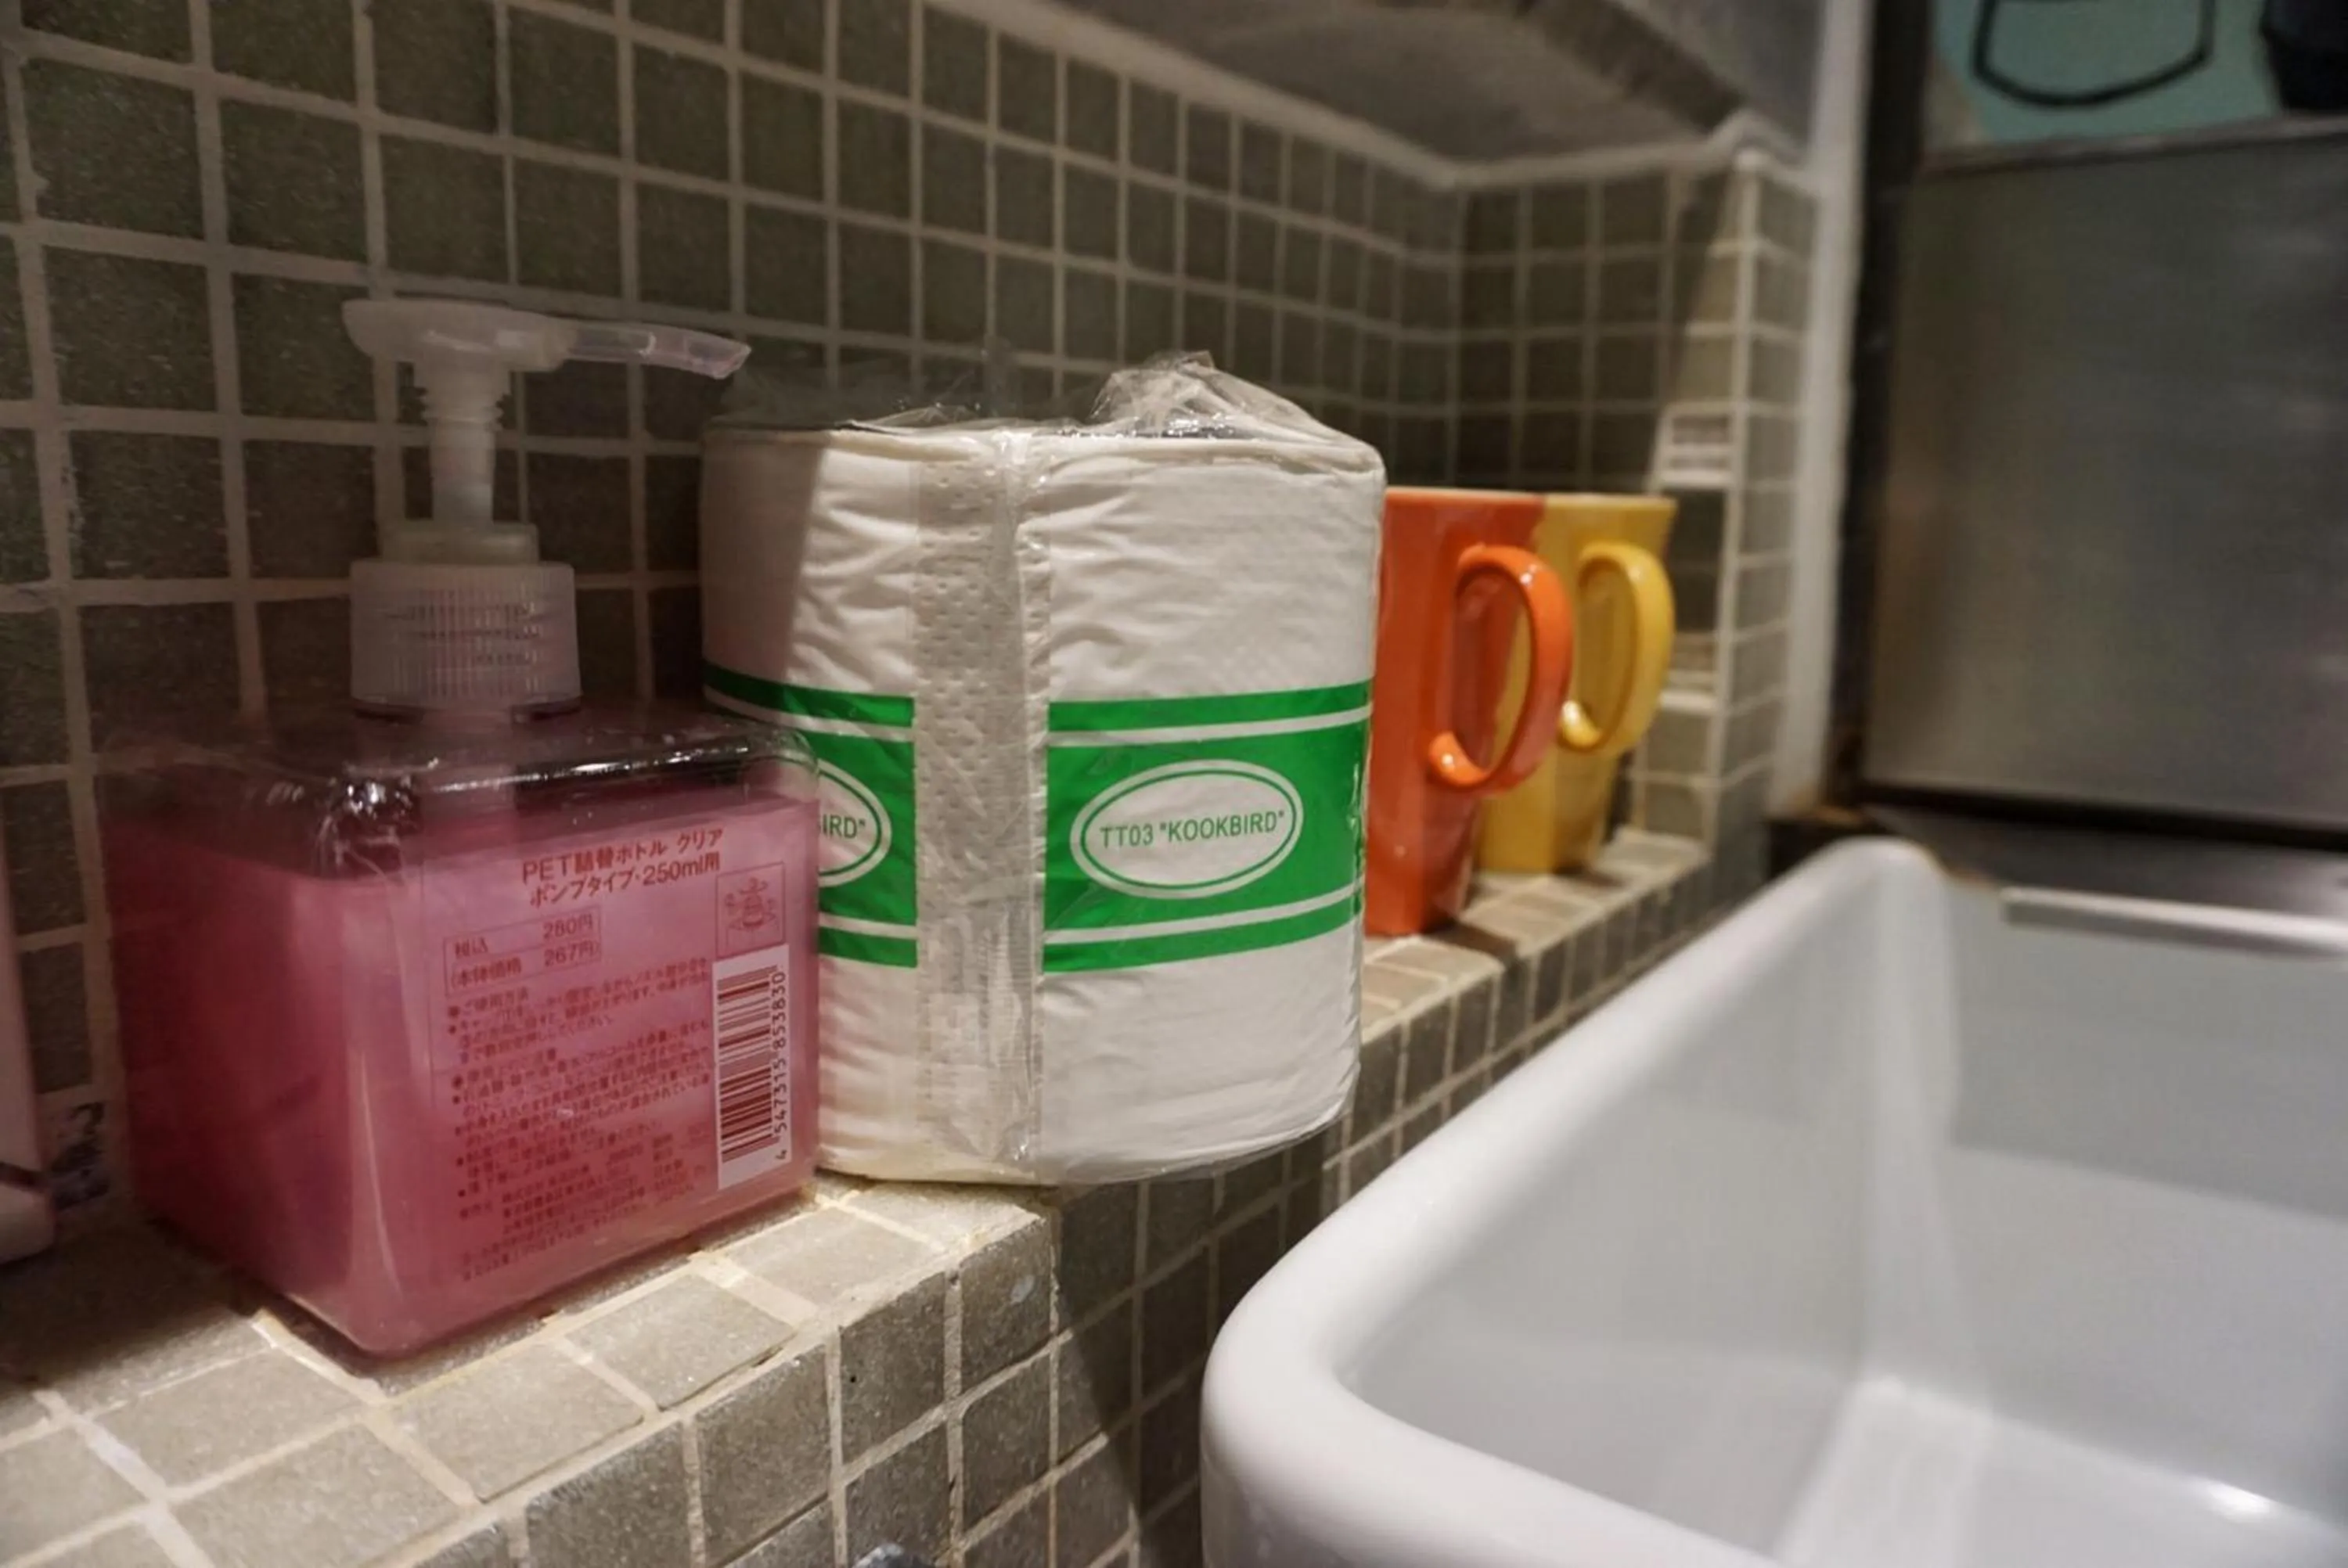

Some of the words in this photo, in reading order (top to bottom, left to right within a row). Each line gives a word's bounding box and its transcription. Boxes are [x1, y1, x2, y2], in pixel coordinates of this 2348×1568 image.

[676, 829, 723, 853] クリア
[1100, 824, 1153, 848] TT03
[1160, 809, 1284, 843] "KOOKBIRD"
[542, 914, 592, 939] 280円
[771, 971, 787, 1050] 853830
[772, 1058, 788, 1135] 547315
